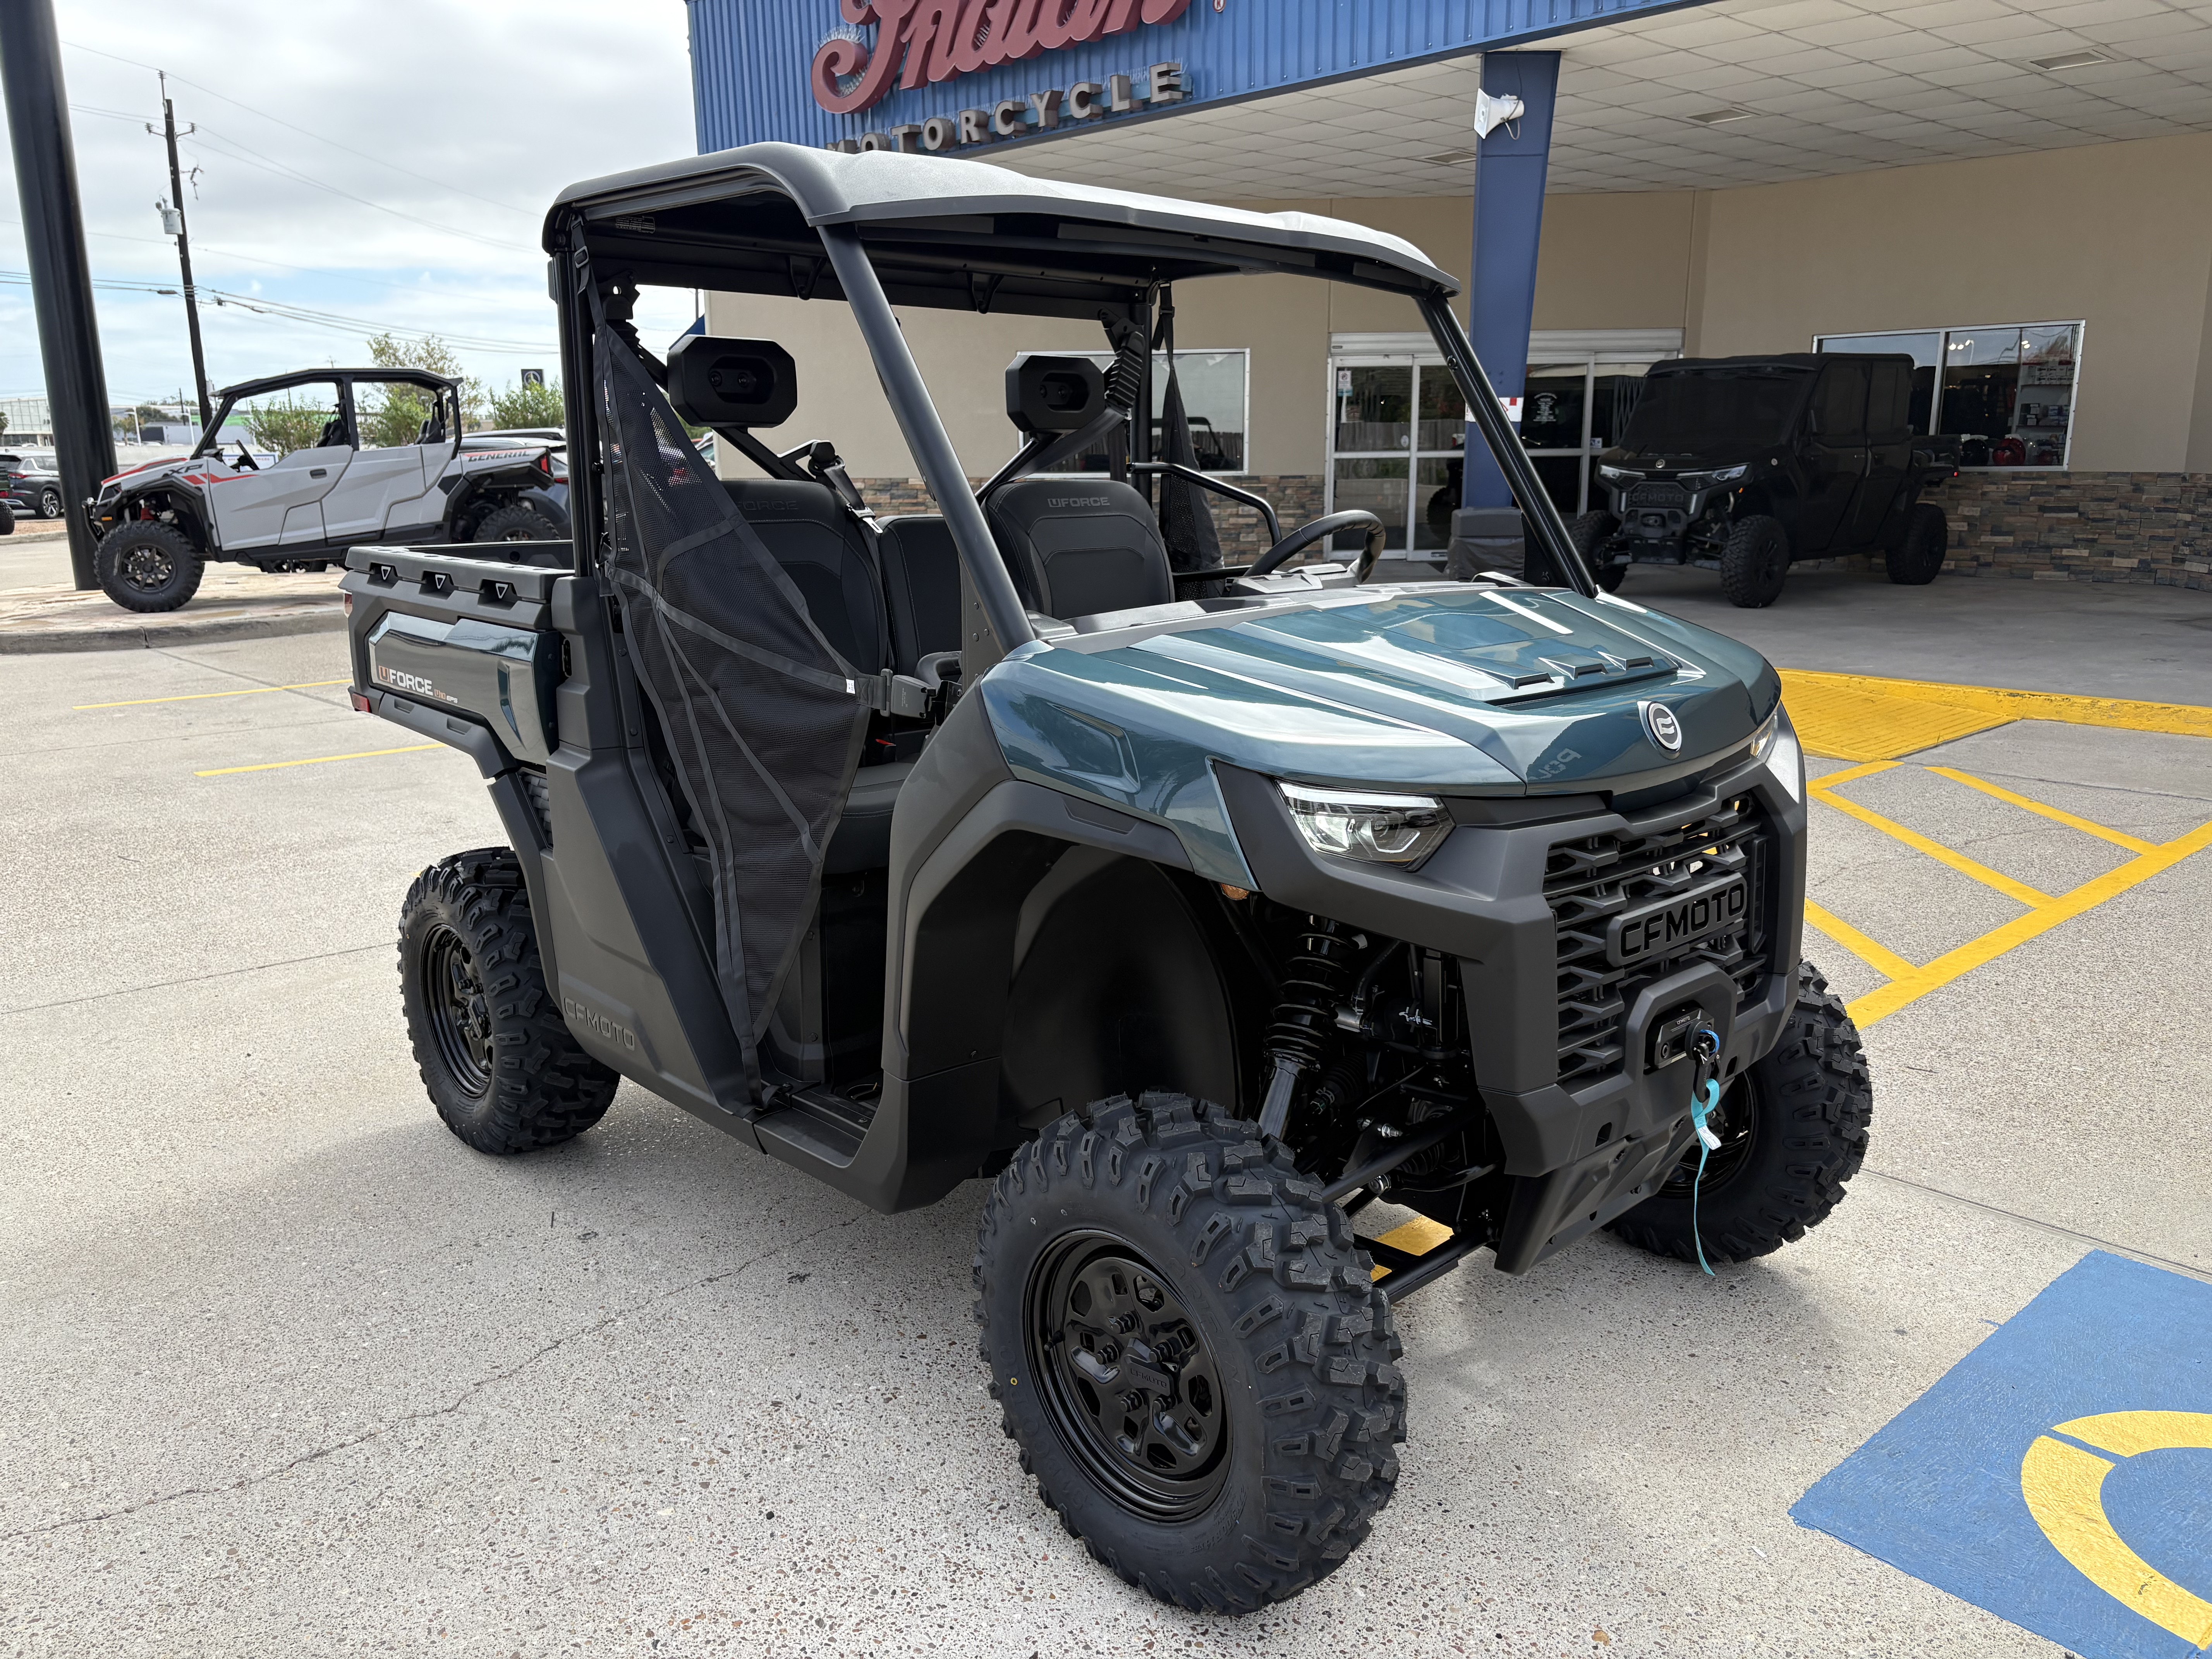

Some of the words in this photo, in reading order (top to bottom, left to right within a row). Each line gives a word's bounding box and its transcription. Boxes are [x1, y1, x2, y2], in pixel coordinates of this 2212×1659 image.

[468, 451, 530, 462] GENERAL
[168, 463, 204, 474] XP
[1621, 883, 1743, 958] CFMOTO
[564, 997, 635, 1051] CFMOTO
[1130, 1368, 1167, 1389] CFMOTO
